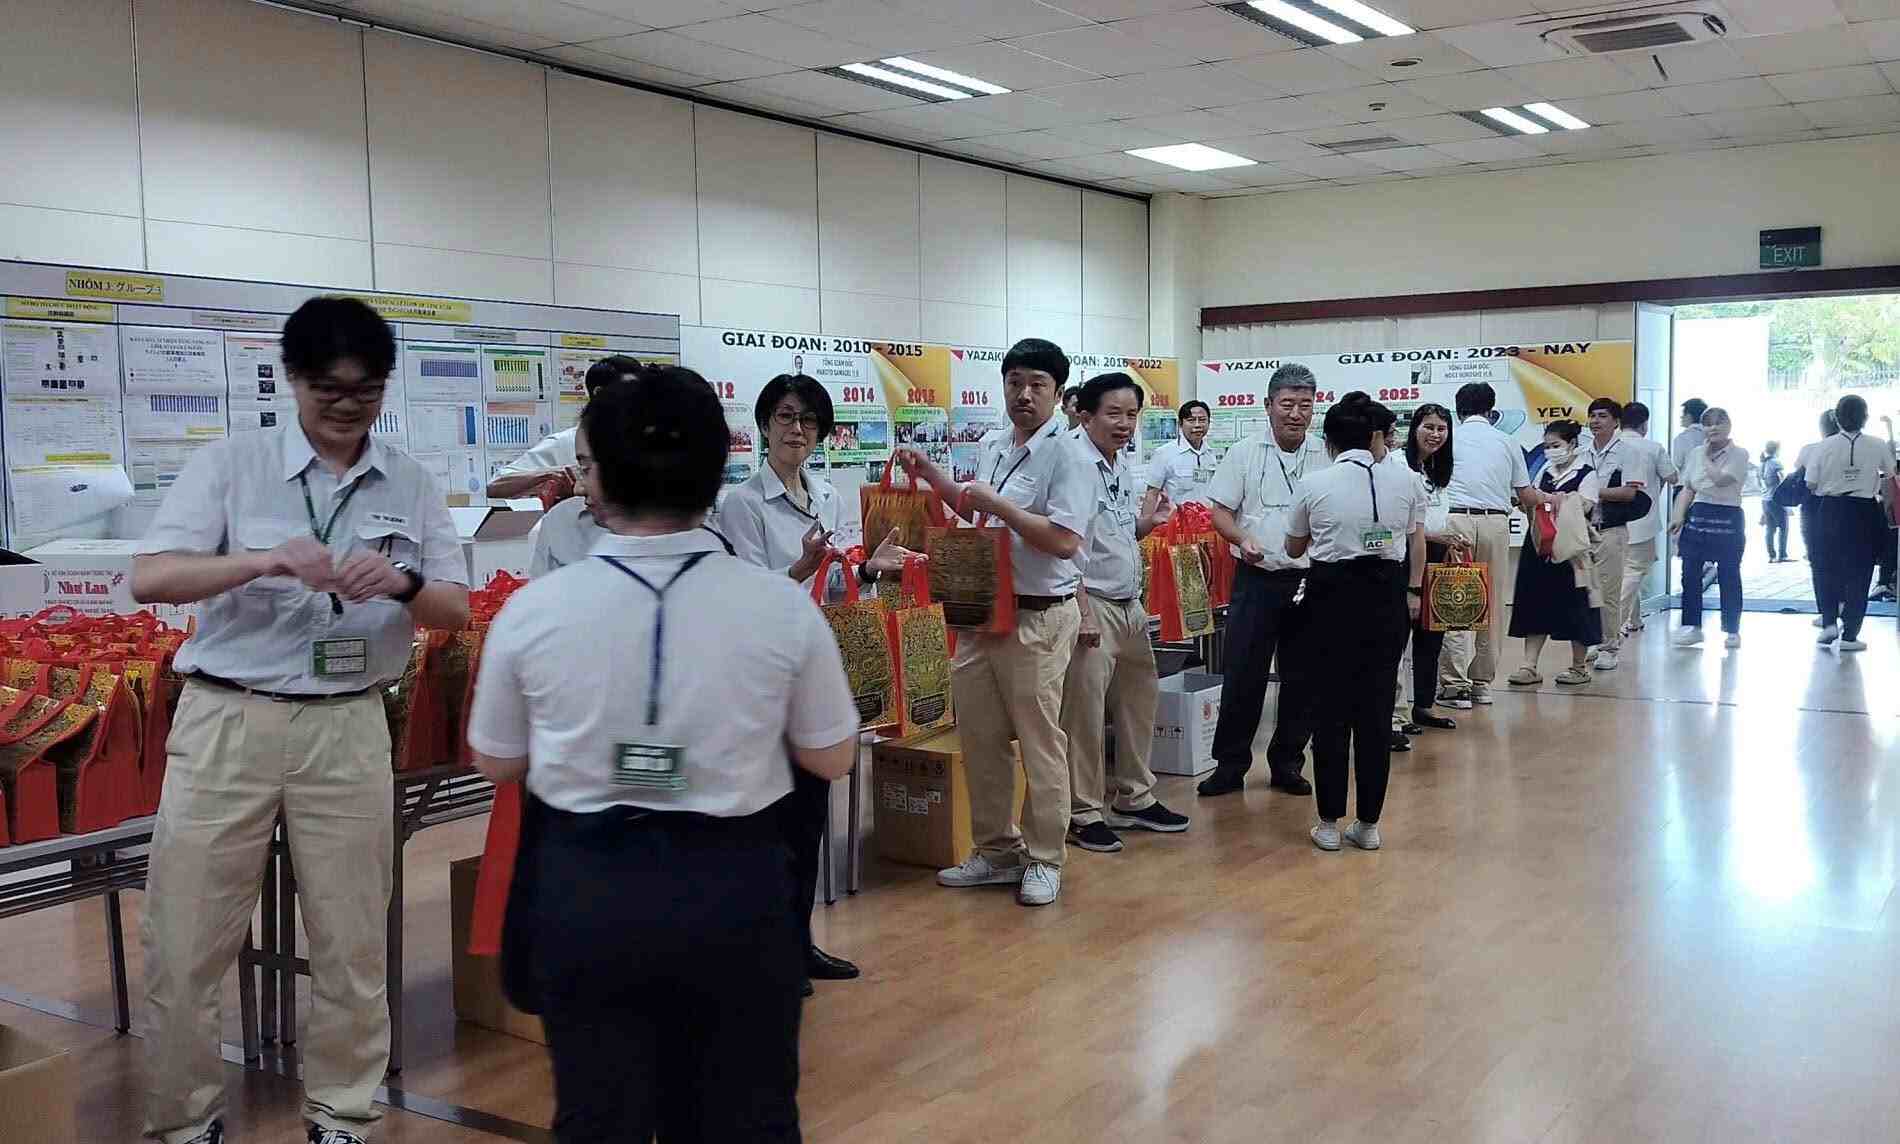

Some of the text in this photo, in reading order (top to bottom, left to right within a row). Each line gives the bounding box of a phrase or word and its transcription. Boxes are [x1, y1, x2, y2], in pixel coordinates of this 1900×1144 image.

[1774, 246, 1806, 264] EXIT
[722, 332, 766, 348] GIAI
[772, 335, 827, 354] ĐOẠN:
[833, 339, 872, 355] 2010
[887, 343, 923, 357] 2015
[1337, 352, 1385, 365] GIAI
[1391, 349, 1459, 362] ĐOẠN:
[1467, 346, 1521, 359] 2023
[1543, 342, 1591, 354] NAY
[1103, 356, 1129, 368] 2016
[1137, 358, 1162, 369] 2022
[1225, 360, 1280, 371] YAZAKI
[843, 386, 875, 403] 2014
[961, 391, 988, 405] 2016
[1217, 394, 1255, 407] 2023
[1315, 390, 1335, 403] 24
[1379, 387, 1420, 401] 2025
[1536, 406, 1573, 418] YEV
[1367, 541, 1384, 549] AC
[58, 580, 109, 594] Như Lan
